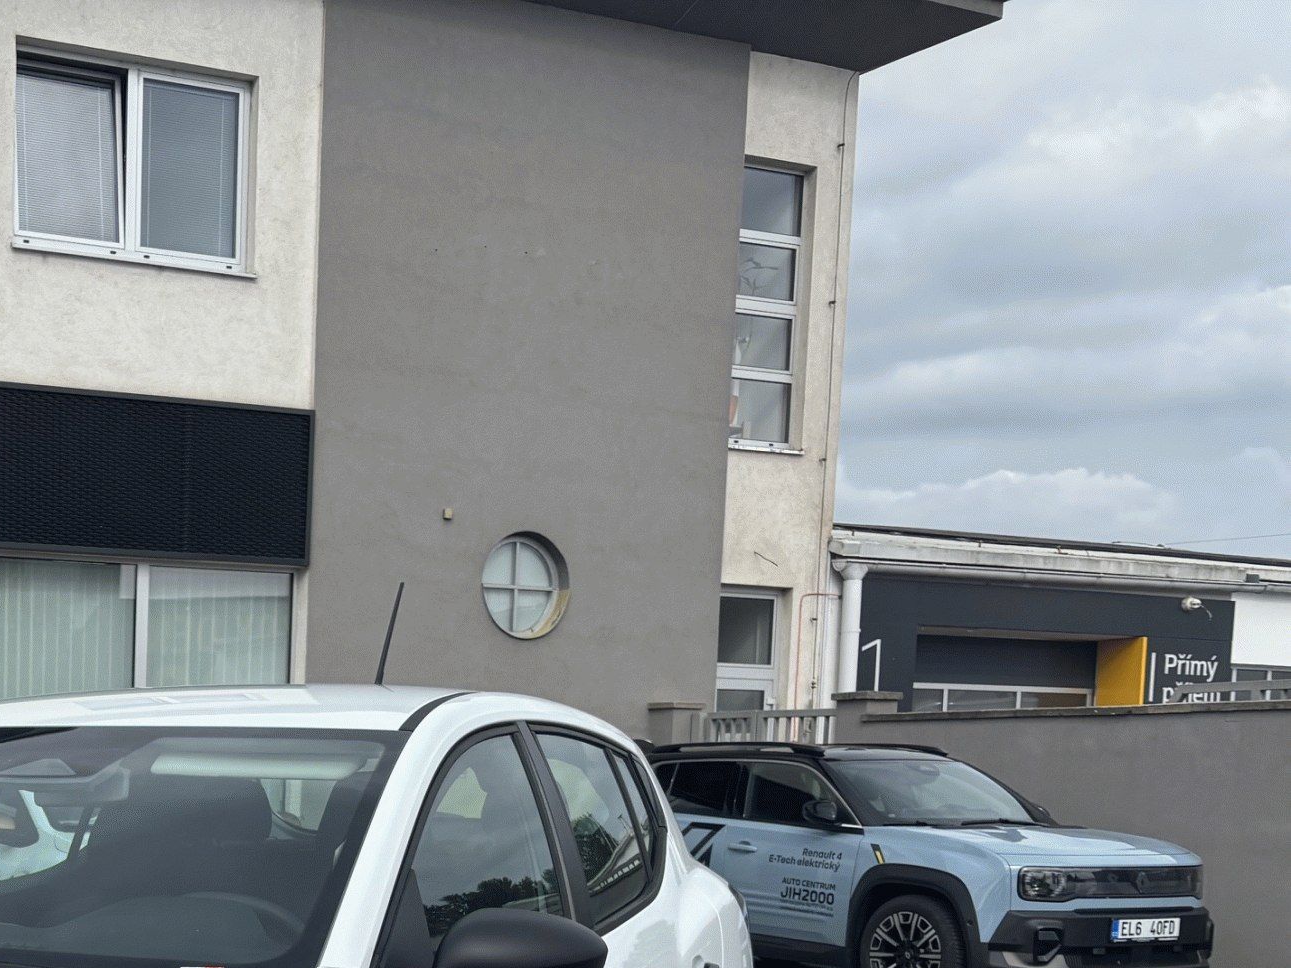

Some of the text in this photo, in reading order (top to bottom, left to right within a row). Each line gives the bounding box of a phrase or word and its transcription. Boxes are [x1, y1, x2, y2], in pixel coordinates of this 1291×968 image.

[1164, 653, 1219, 682] Přímý
[802, 848, 843, 860] Renault 4
[768, 854, 841, 872] E-Tech elektrický
[782, 876, 837, 891] AUTO CENTRUM
[780, 886, 835, 905] JIH2000
[1121, 921, 1143, 937] EL6
